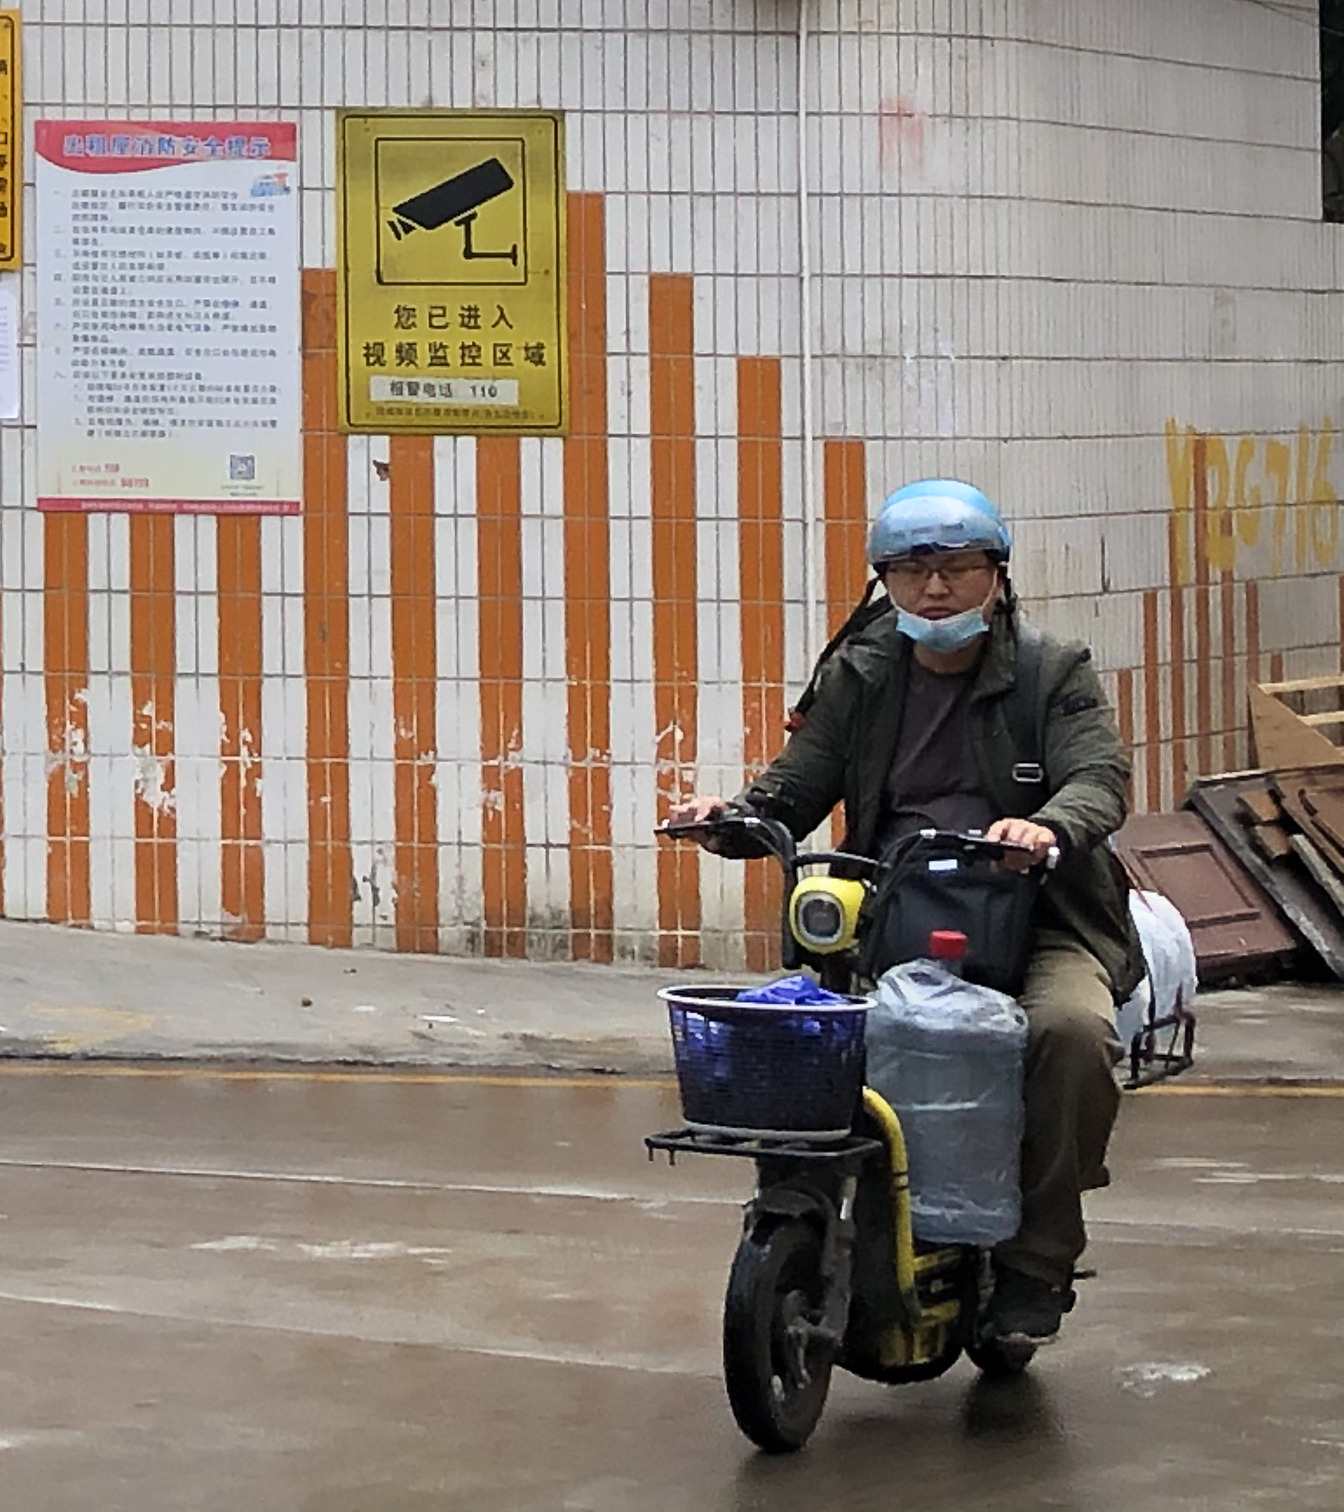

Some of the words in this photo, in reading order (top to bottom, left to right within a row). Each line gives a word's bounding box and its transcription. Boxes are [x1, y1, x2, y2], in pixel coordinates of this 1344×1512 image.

[393, 304, 514, 329] 您已进入
[362, 341, 547, 368] 视频监控区域
[390, 380, 453, 398] 报警电话
[470, 384, 499, 398] 110
